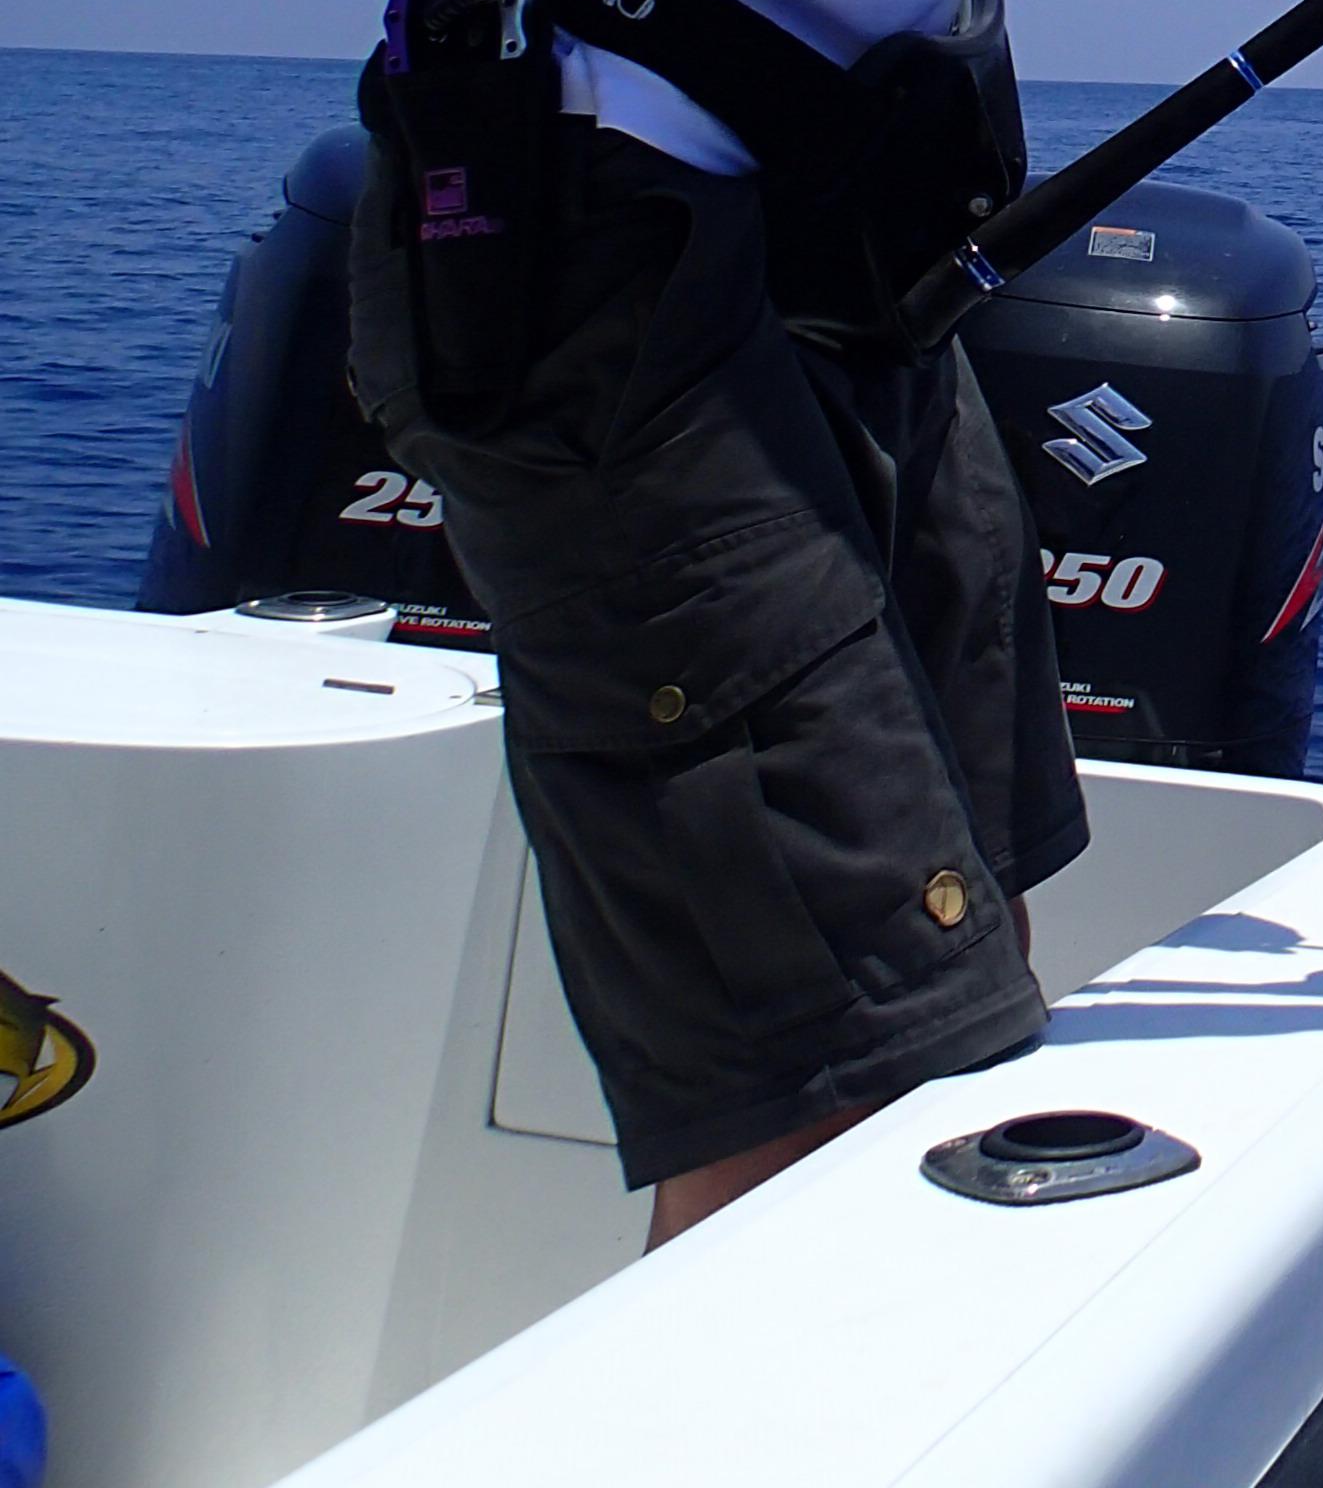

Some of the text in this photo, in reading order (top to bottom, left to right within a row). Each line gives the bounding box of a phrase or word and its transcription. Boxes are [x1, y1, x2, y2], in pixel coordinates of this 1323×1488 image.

[338, 470, 445, 531] 25
[420, 616, 492, 632] ROTATION
[1060, 681, 1092, 694] ZUKI
[1066, 693, 1136, 709] ROTATION
